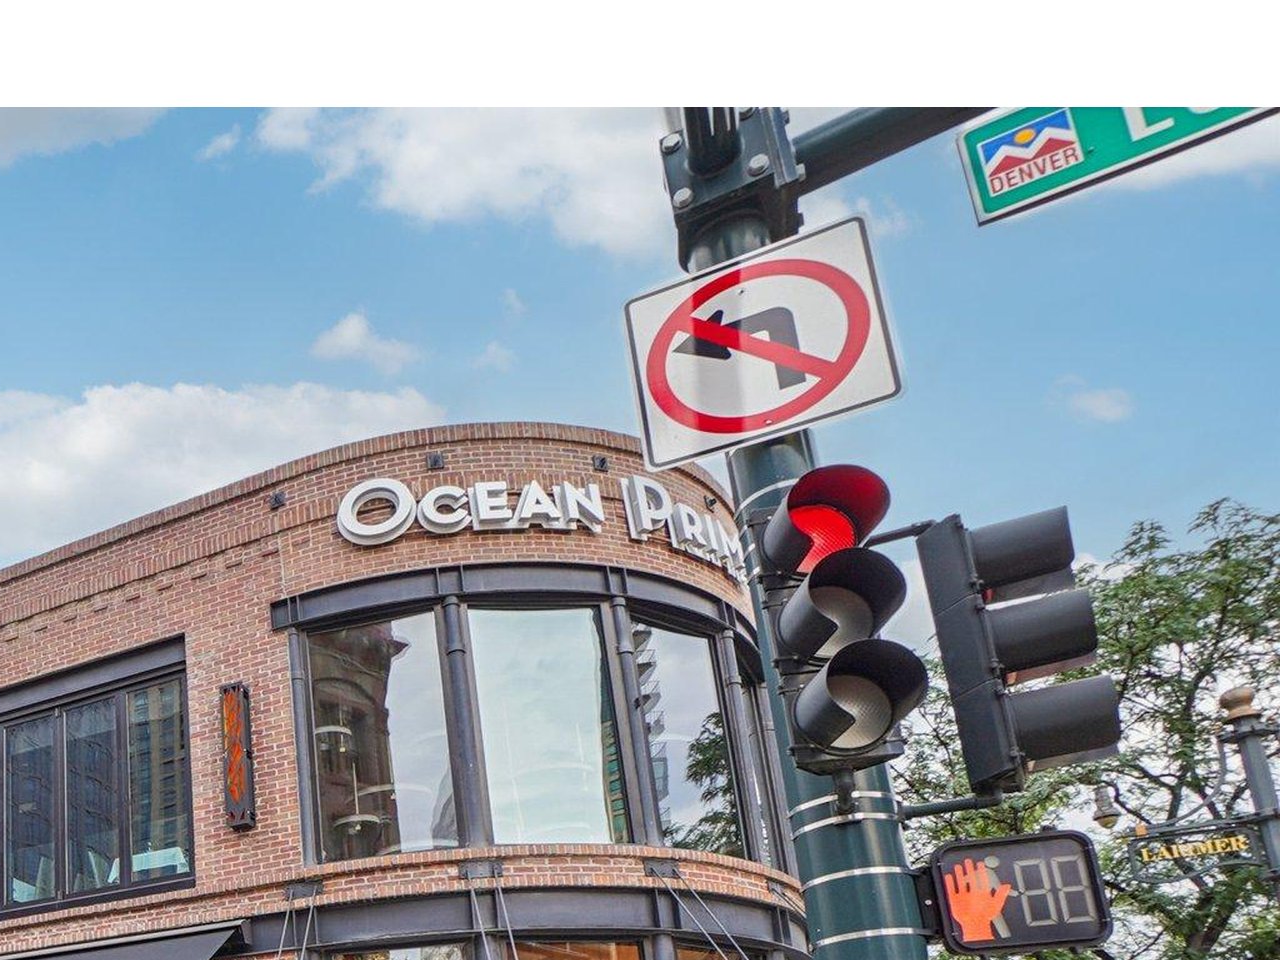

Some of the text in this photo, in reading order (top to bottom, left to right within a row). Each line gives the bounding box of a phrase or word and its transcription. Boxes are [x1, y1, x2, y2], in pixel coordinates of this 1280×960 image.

[989, 147, 1080, 195] DENVER
[336, 474, 747, 574] OCEAN PRIM
